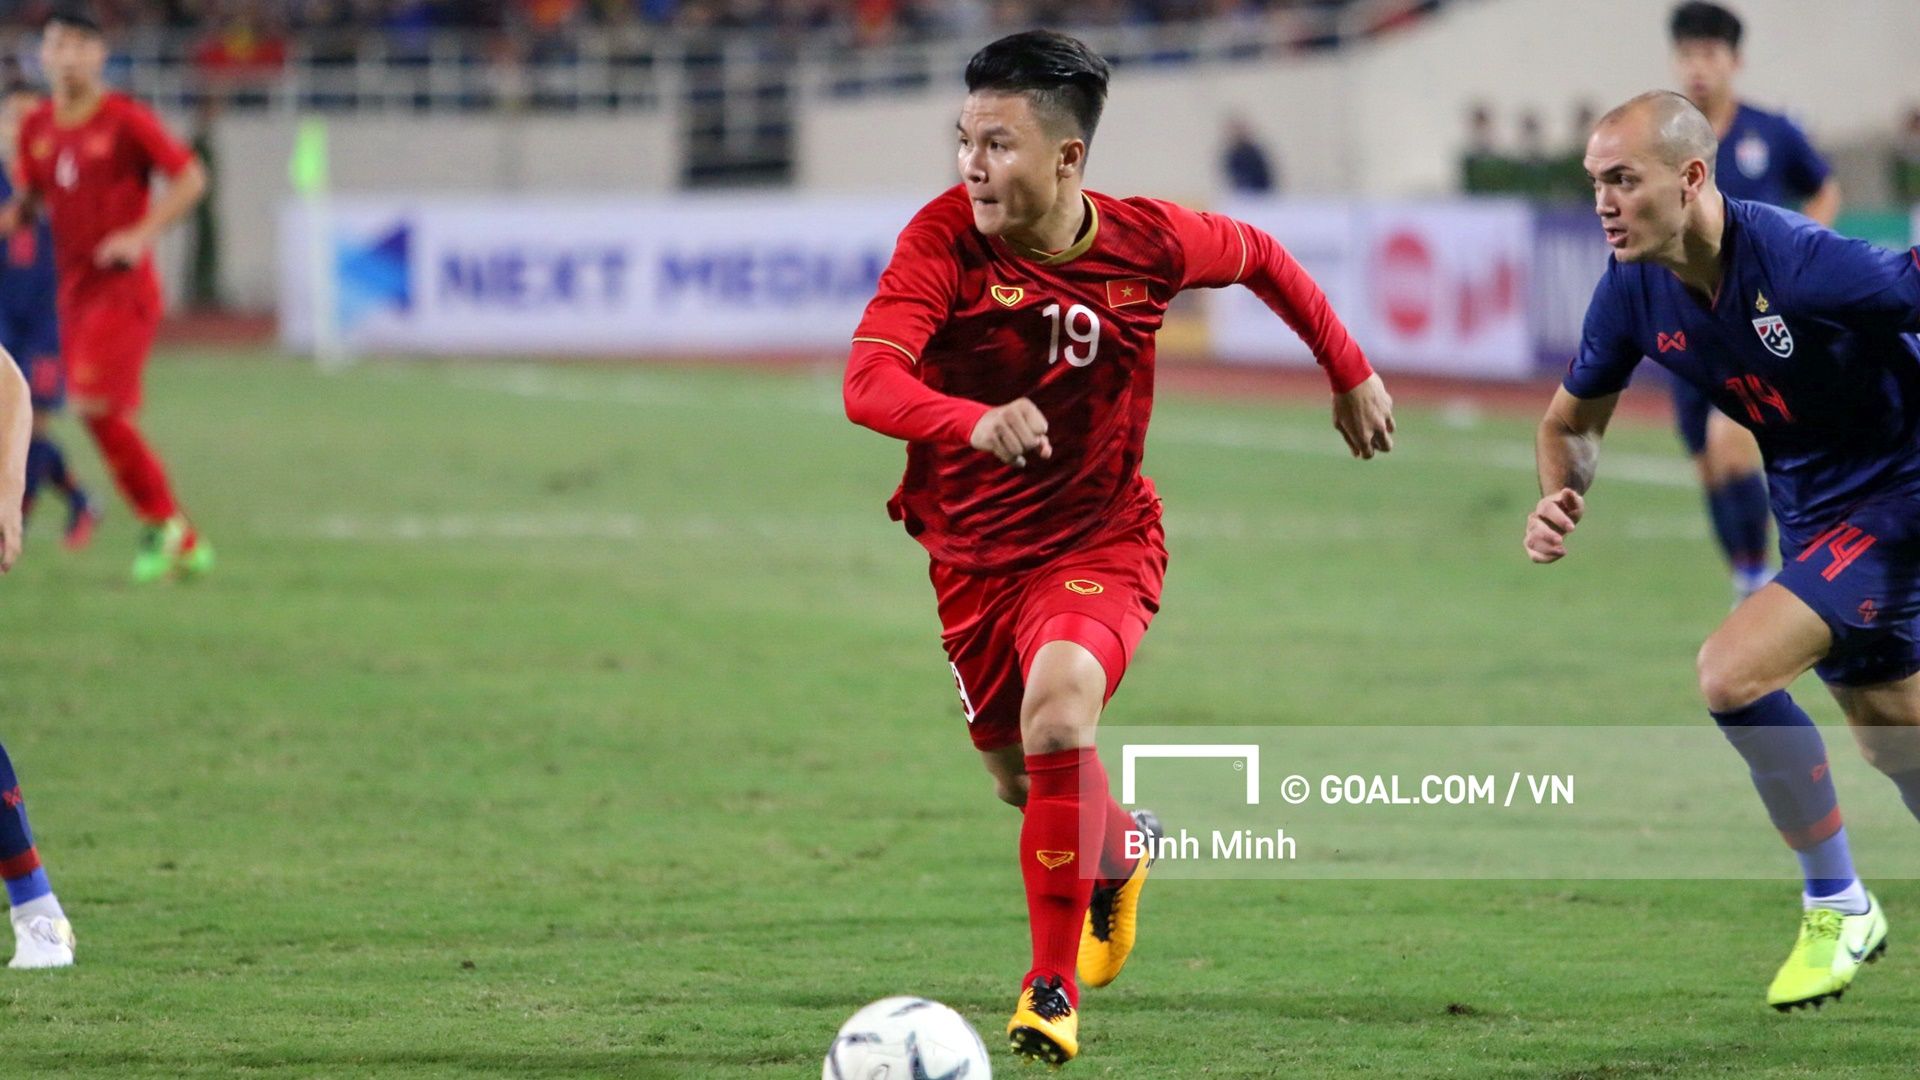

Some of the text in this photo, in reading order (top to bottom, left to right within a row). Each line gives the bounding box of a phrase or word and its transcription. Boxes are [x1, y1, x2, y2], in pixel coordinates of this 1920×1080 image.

[441, 251, 627, 303] NEXT
[1042, 303, 1100, 367] 19
[1725, 373, 1794, 424] 14
[1796, 521, 1878, 582] 14
